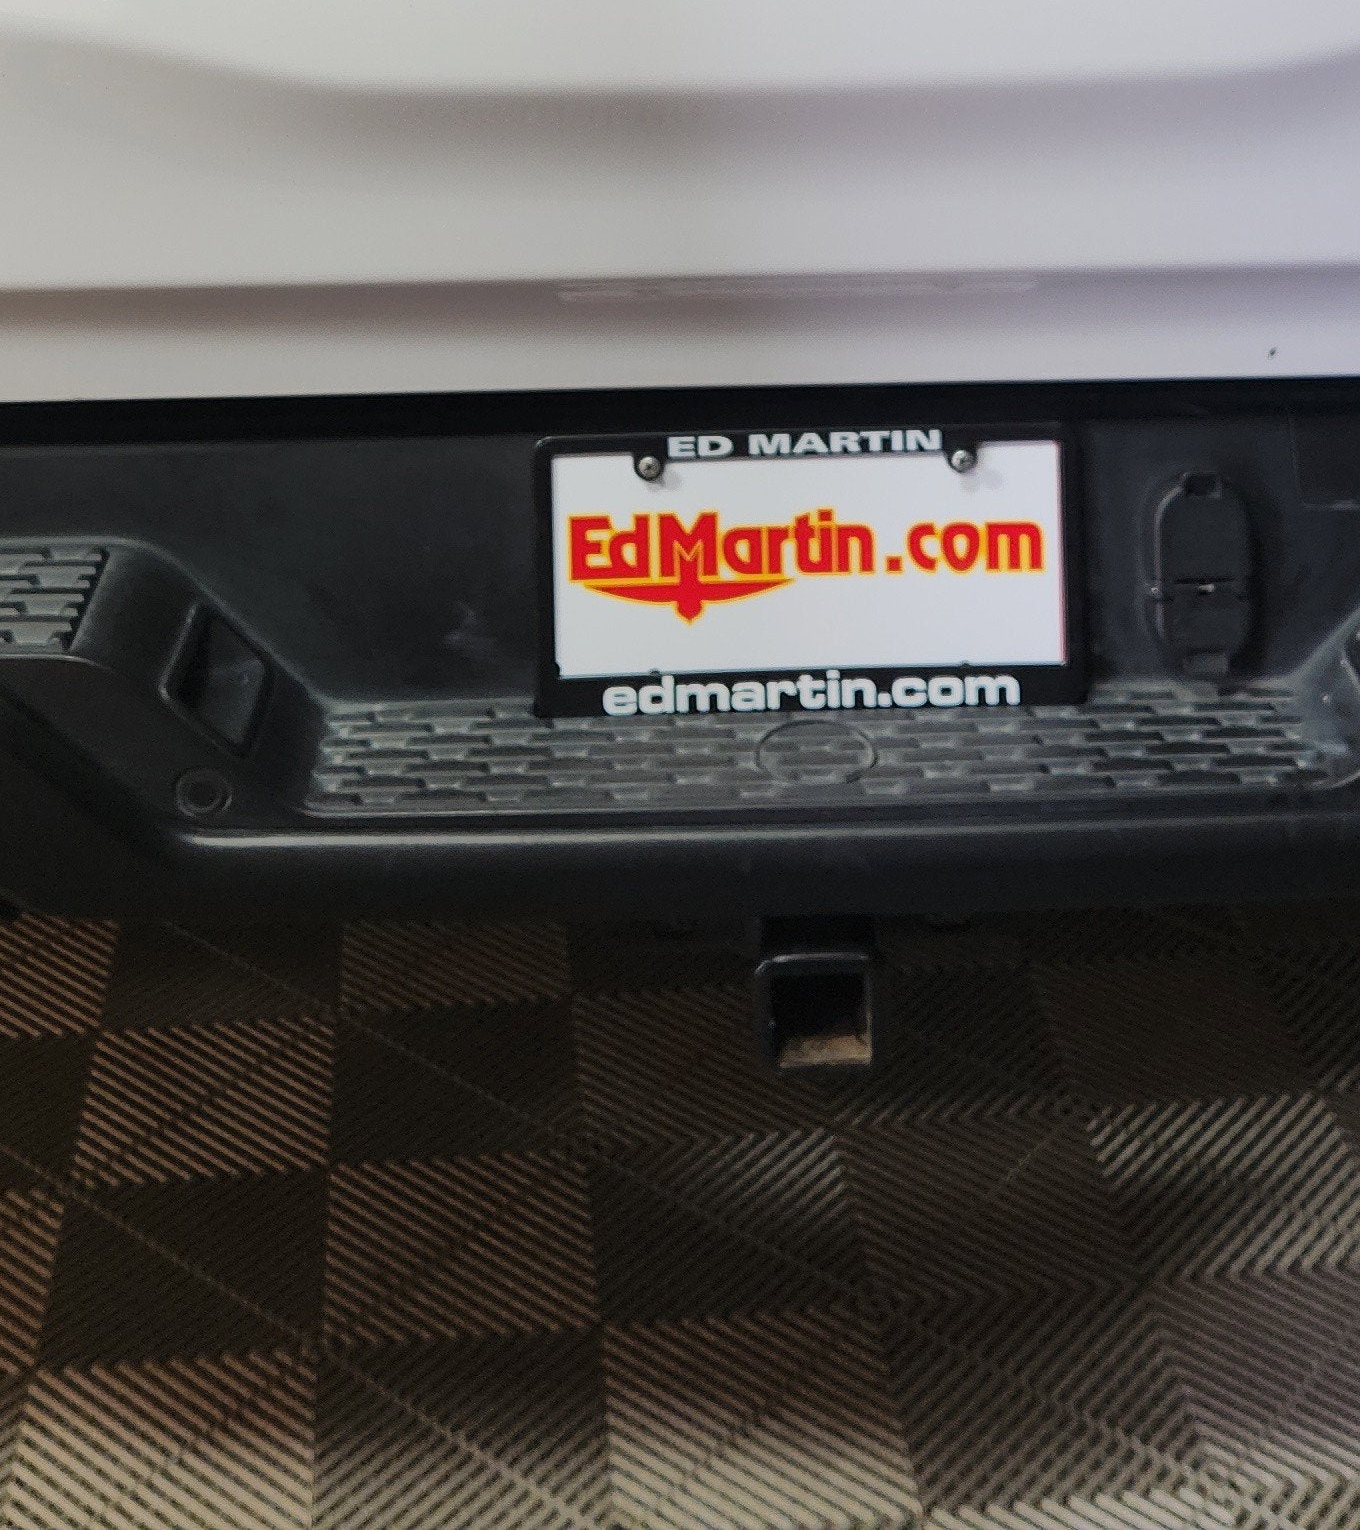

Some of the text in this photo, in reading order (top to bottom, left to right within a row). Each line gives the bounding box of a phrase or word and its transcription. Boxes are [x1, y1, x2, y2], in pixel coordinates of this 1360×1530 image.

[666, 428, 943, 460] ED MARTIN
[601, 669, 1021, 716] edmartin.com
